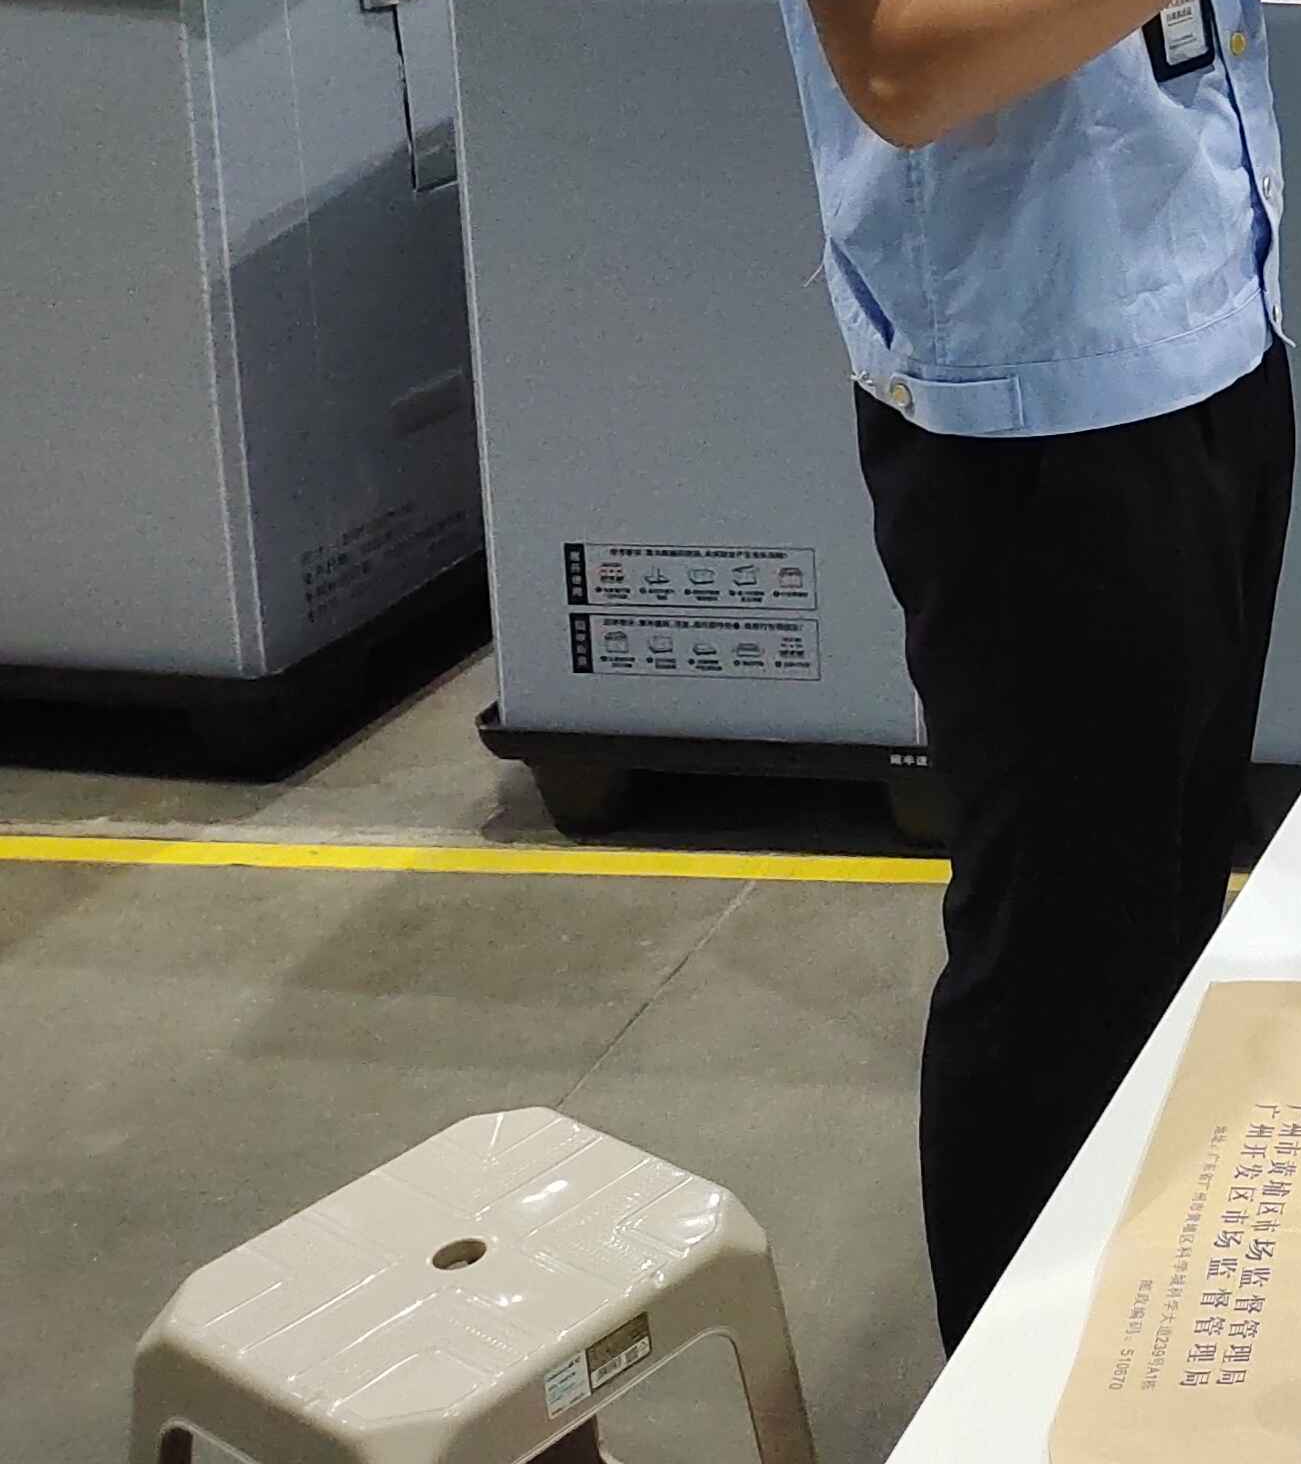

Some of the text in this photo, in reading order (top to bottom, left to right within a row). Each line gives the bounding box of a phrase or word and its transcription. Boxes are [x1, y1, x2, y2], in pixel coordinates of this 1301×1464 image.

[1179, 1102, 1281, 1389] 广州开发区市场监督管理局
